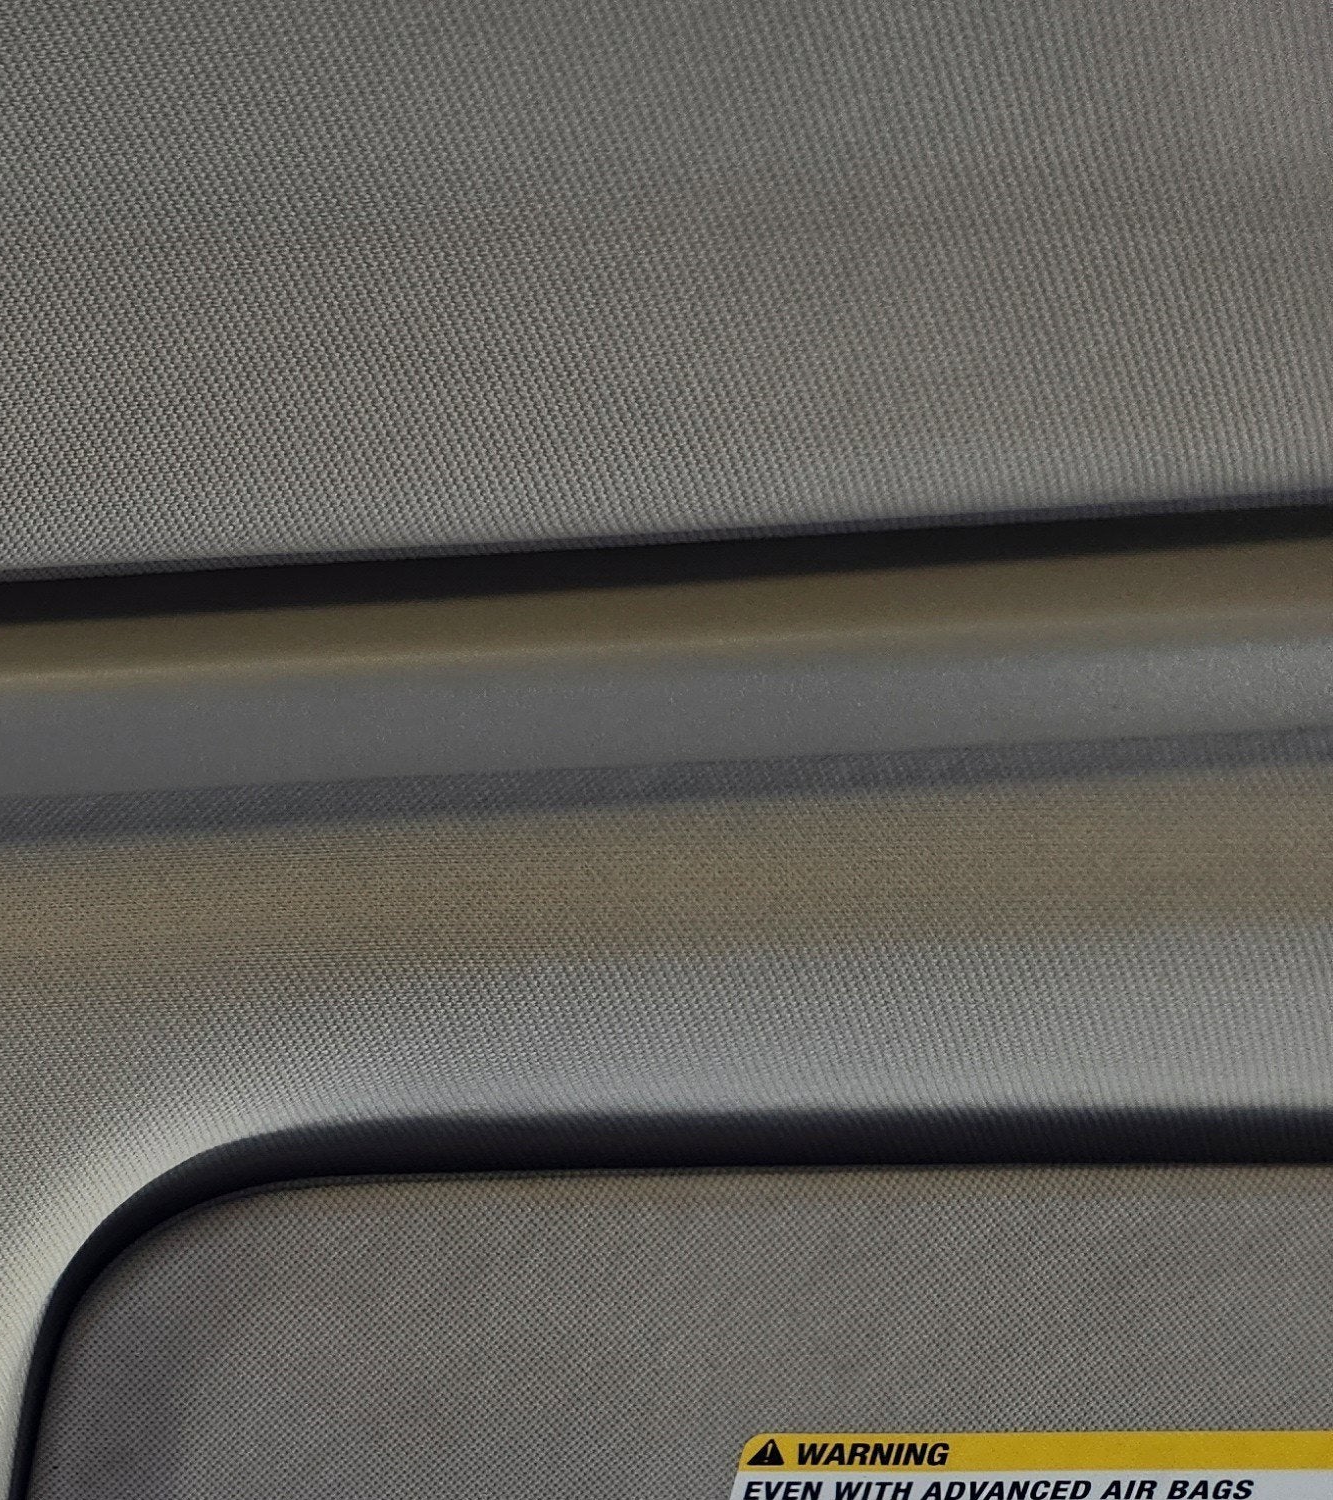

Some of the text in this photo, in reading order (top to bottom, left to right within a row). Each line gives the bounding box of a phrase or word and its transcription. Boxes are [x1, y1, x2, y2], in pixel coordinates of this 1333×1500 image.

[797, 1442, 950, 1467] WARNING
[743, 1479, 1255, 1500] EVEN WITH ADVANCED AIR BAGS
